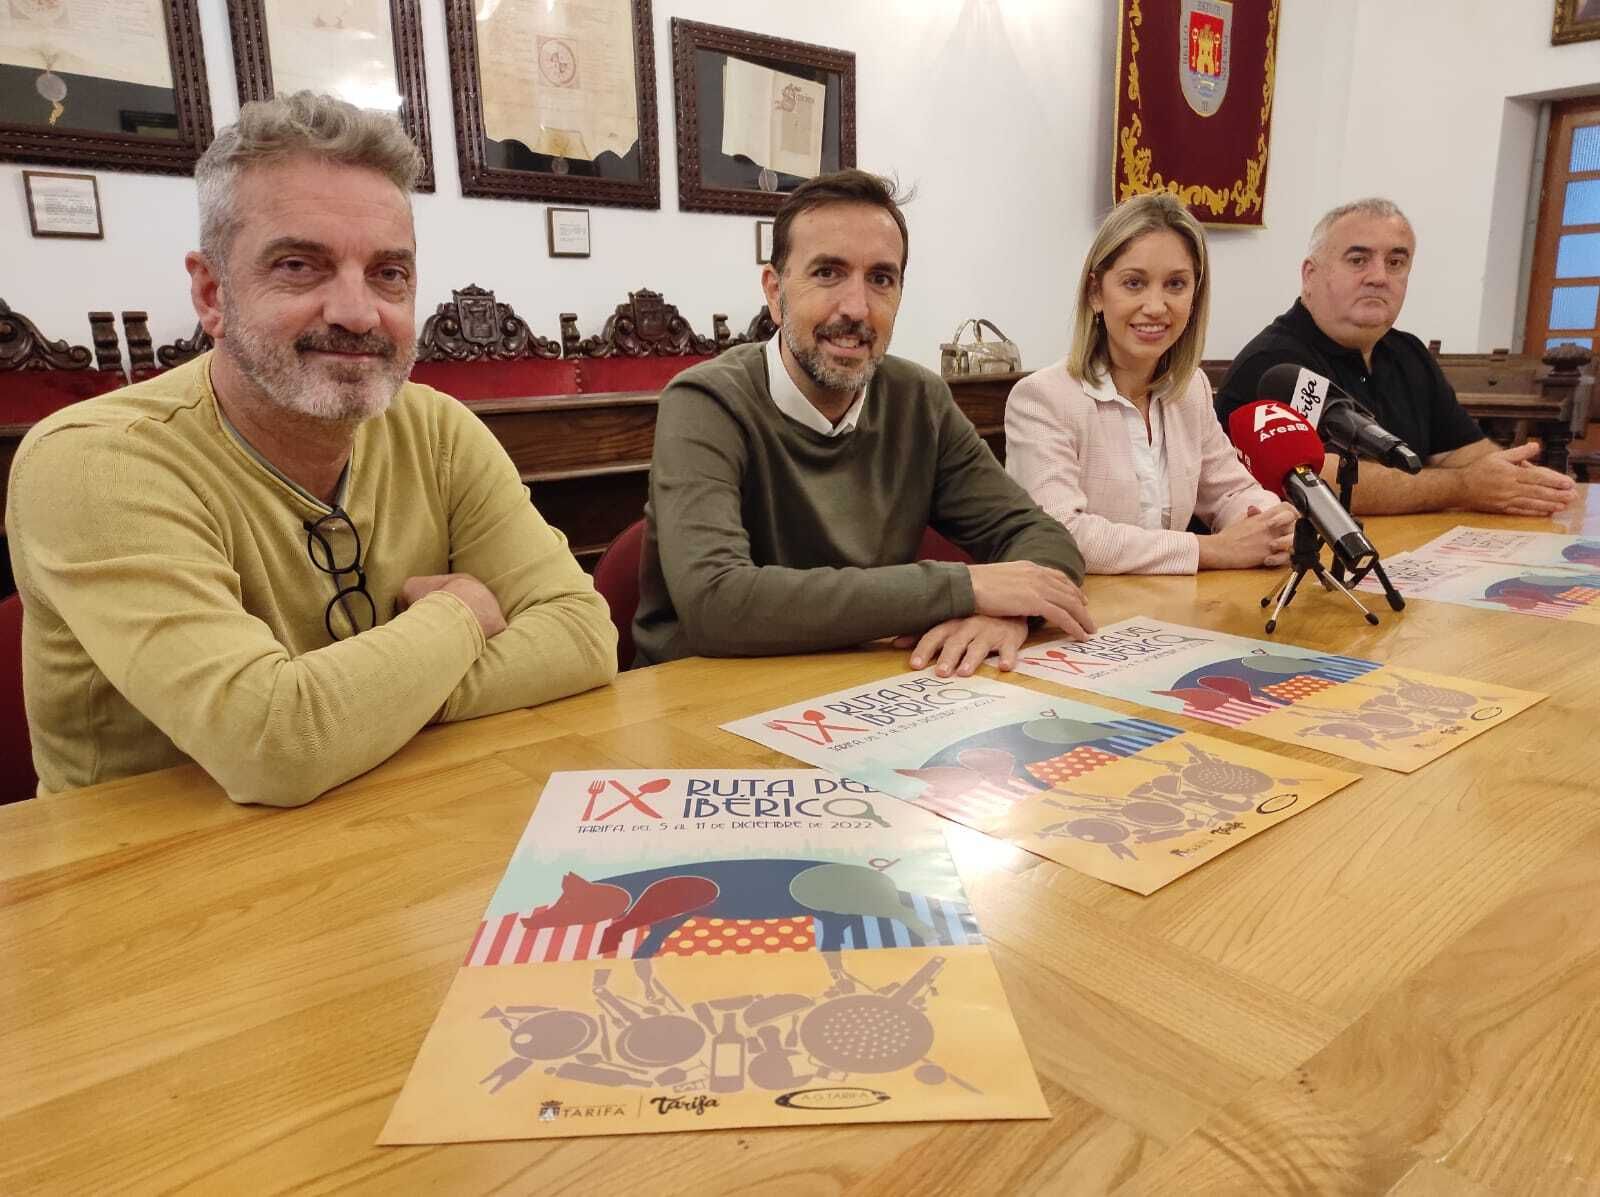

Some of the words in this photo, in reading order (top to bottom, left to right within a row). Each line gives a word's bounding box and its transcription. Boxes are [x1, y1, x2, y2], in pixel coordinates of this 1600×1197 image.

[1297, 379, 1321, 419] rifa
[824, 688, 910, 716] RUTA
[900, 677, 954, 693] DEL
[686, 778, 795, 797] RUTA
[659, 822, 668, 831] 5
[710, 822, 726, 830] DE
[731, 820, 802, 829] DICIEMBRE
[808, 821, 823, 829] DE
[831, 820, 872, 829] 2022
[563, 1105, 626, 1118] TARIFA
[650, 1095, 720, 1116] Tarifa
